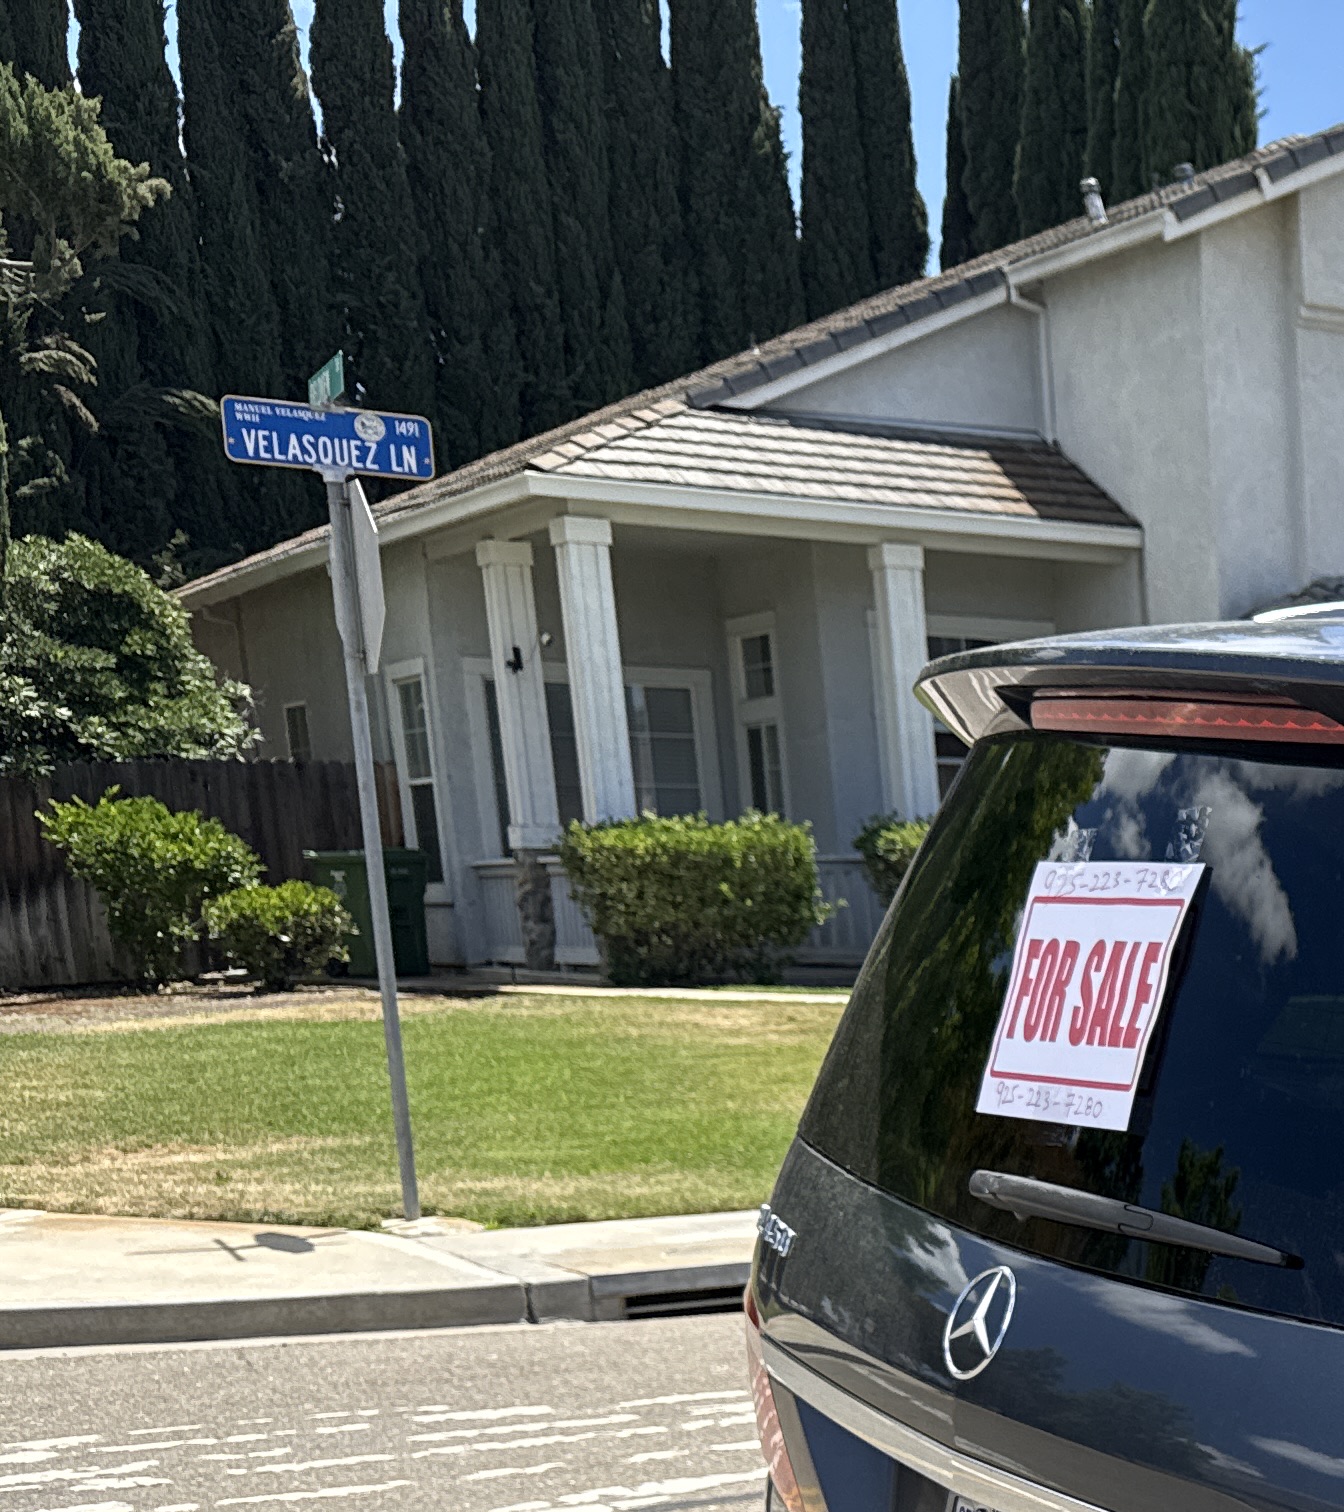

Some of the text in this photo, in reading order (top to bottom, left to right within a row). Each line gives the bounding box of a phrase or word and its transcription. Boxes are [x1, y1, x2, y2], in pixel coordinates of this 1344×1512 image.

[234, 402, 327, 422] MANUEL VELASQUEZ
[235, 411, 260, 423] WWII
[394, 420, 421, 439] 1491
[241, 427, 419, 474] VELASQUEZ LN
[1006, 938, 1163, 1049] FOR SALE
[995, 1081, 1103, 1118] 925-223-7280
